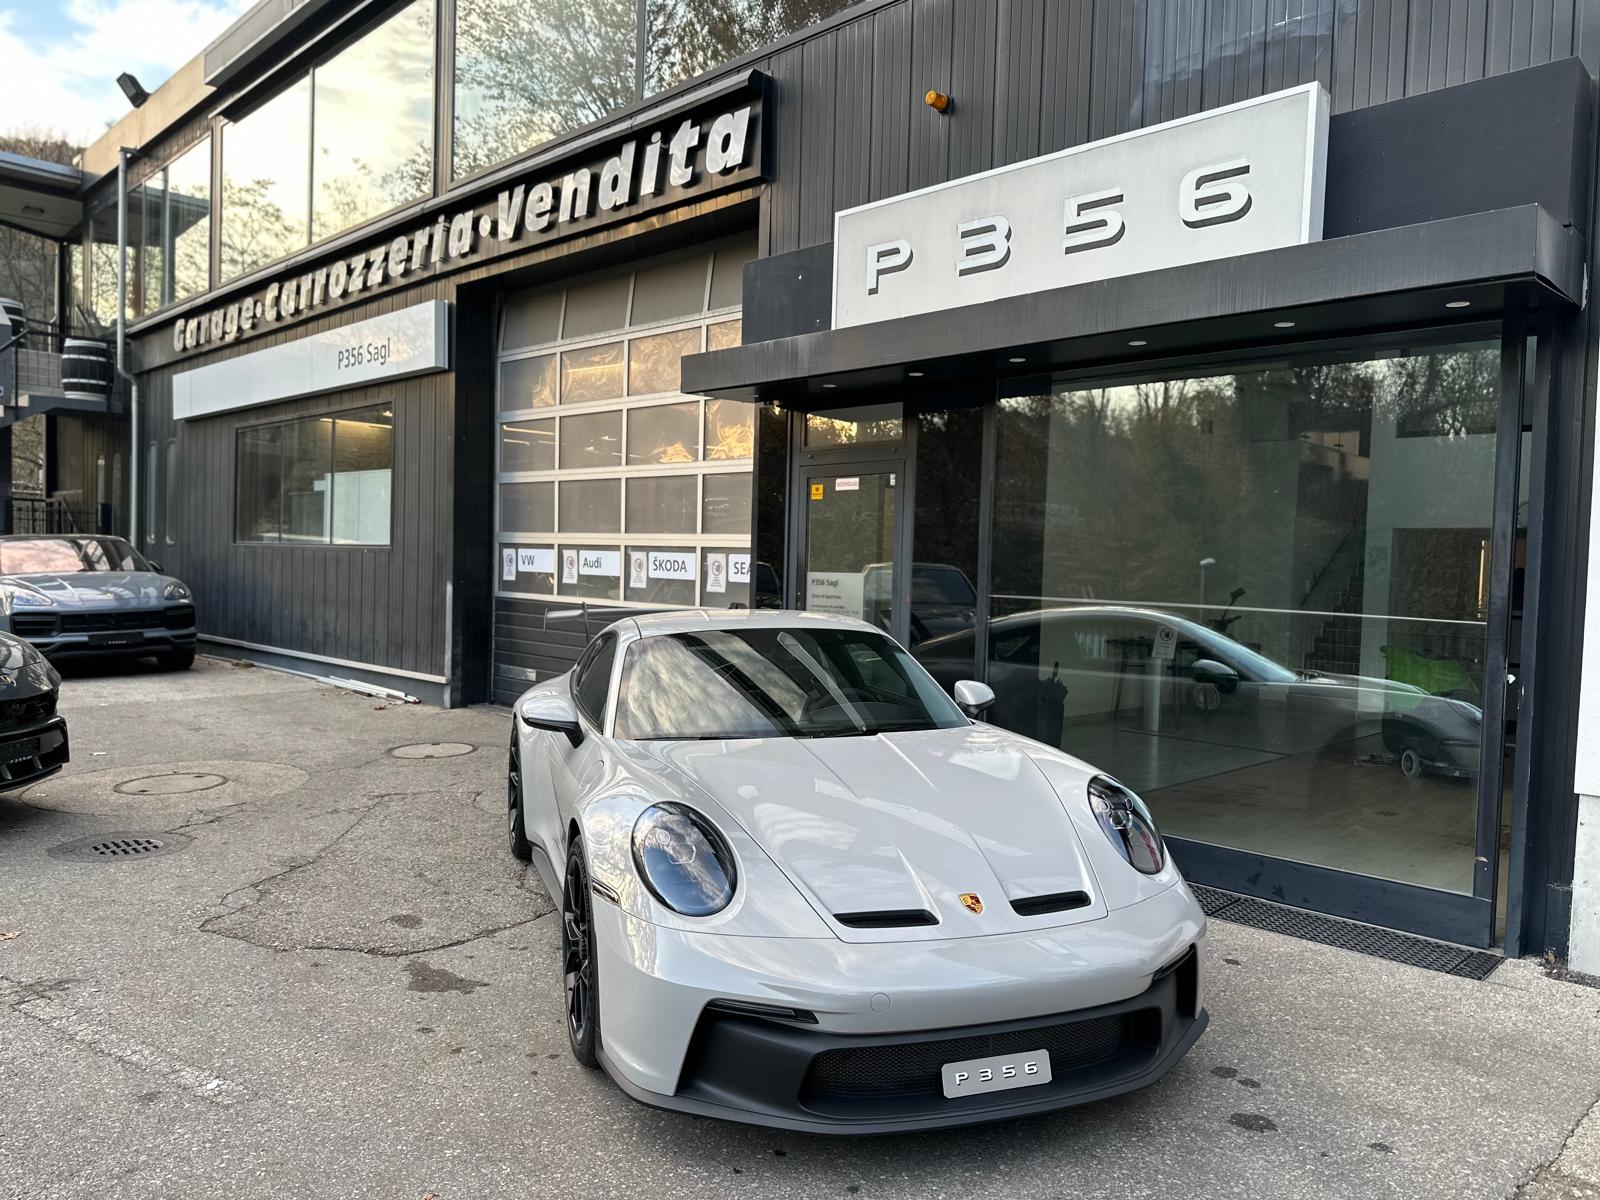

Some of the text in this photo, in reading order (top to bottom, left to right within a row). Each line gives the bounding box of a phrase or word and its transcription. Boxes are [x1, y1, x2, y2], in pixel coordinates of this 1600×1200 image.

[174, 106, 750, 353] Garage Carrozzeria Vendita
[338, 337, 390, 370] P356 Sagl
[521, 554, 535, 566] VW
[583, 556, 602, 569] Audi
[653, 556, 687, 573] ŠKODA
